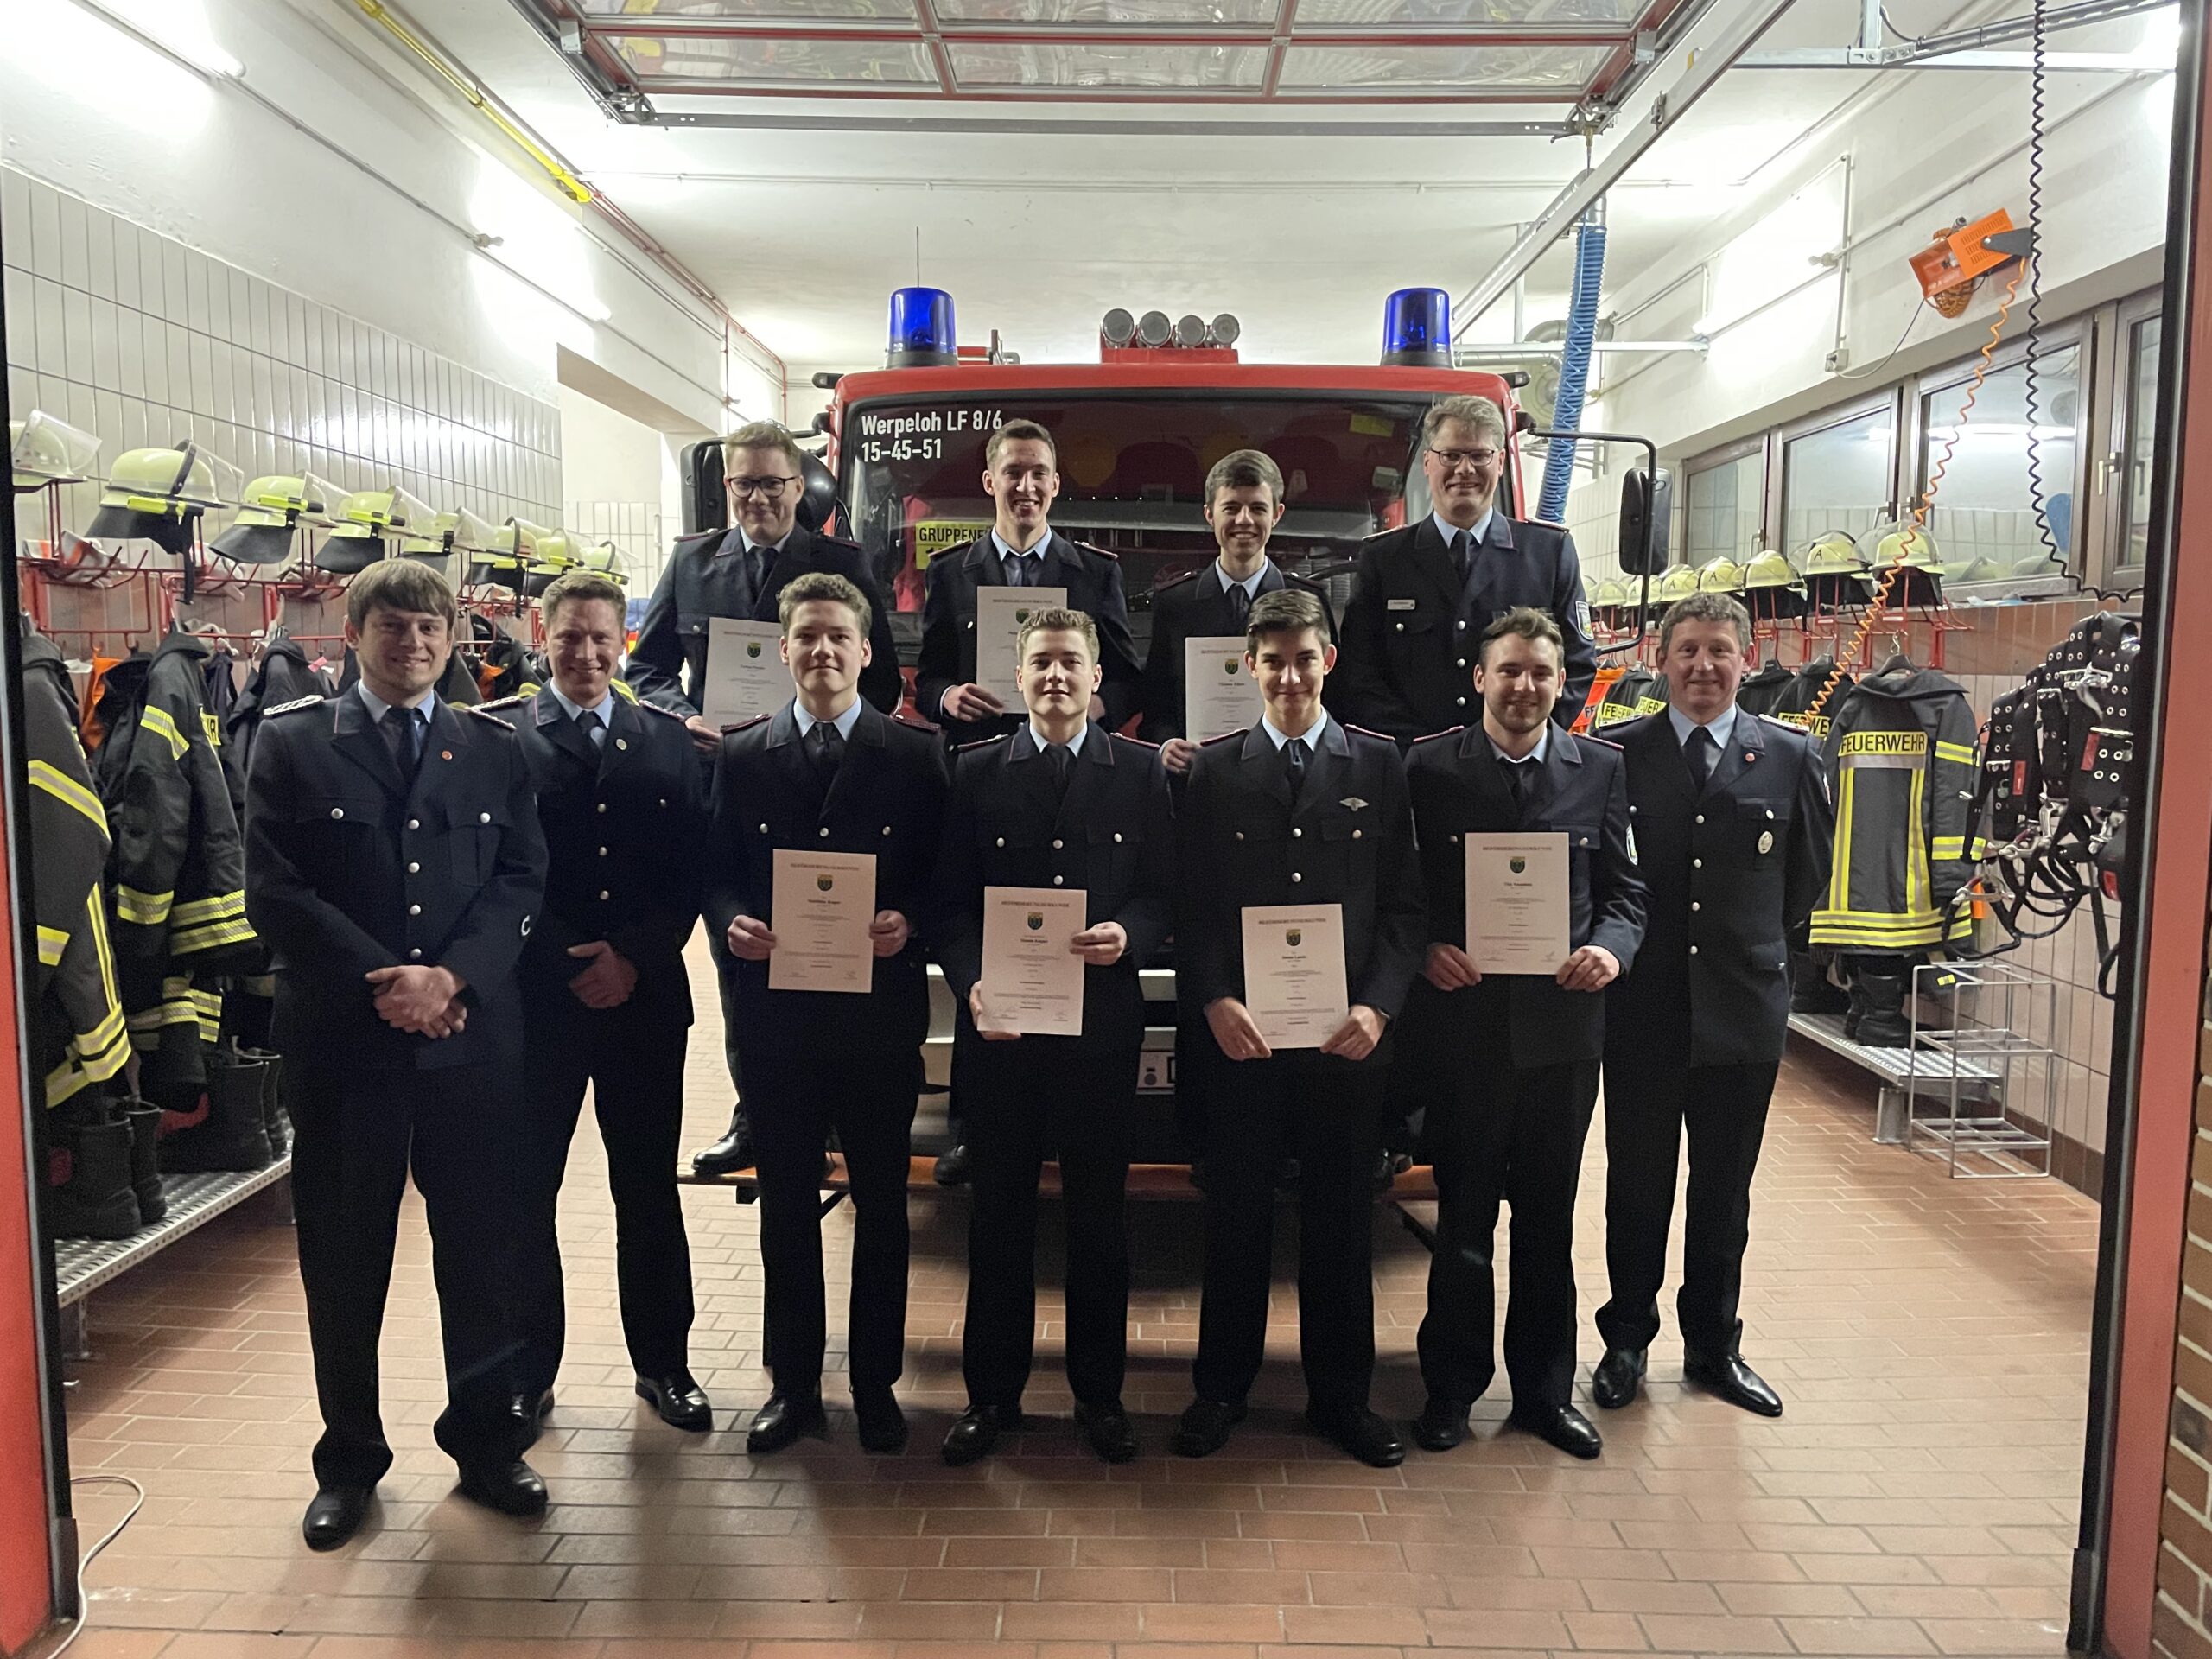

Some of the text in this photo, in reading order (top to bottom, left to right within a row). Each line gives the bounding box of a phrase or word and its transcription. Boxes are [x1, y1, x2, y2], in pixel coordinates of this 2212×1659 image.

[861, 410, 1002, 439] Werpeloh LF 8/6
[861, 438, 942, 462] 15-45-51
[1813, 548, 1822, 561] A
[1840, 734, 1925, 754] FEUERWEHR
